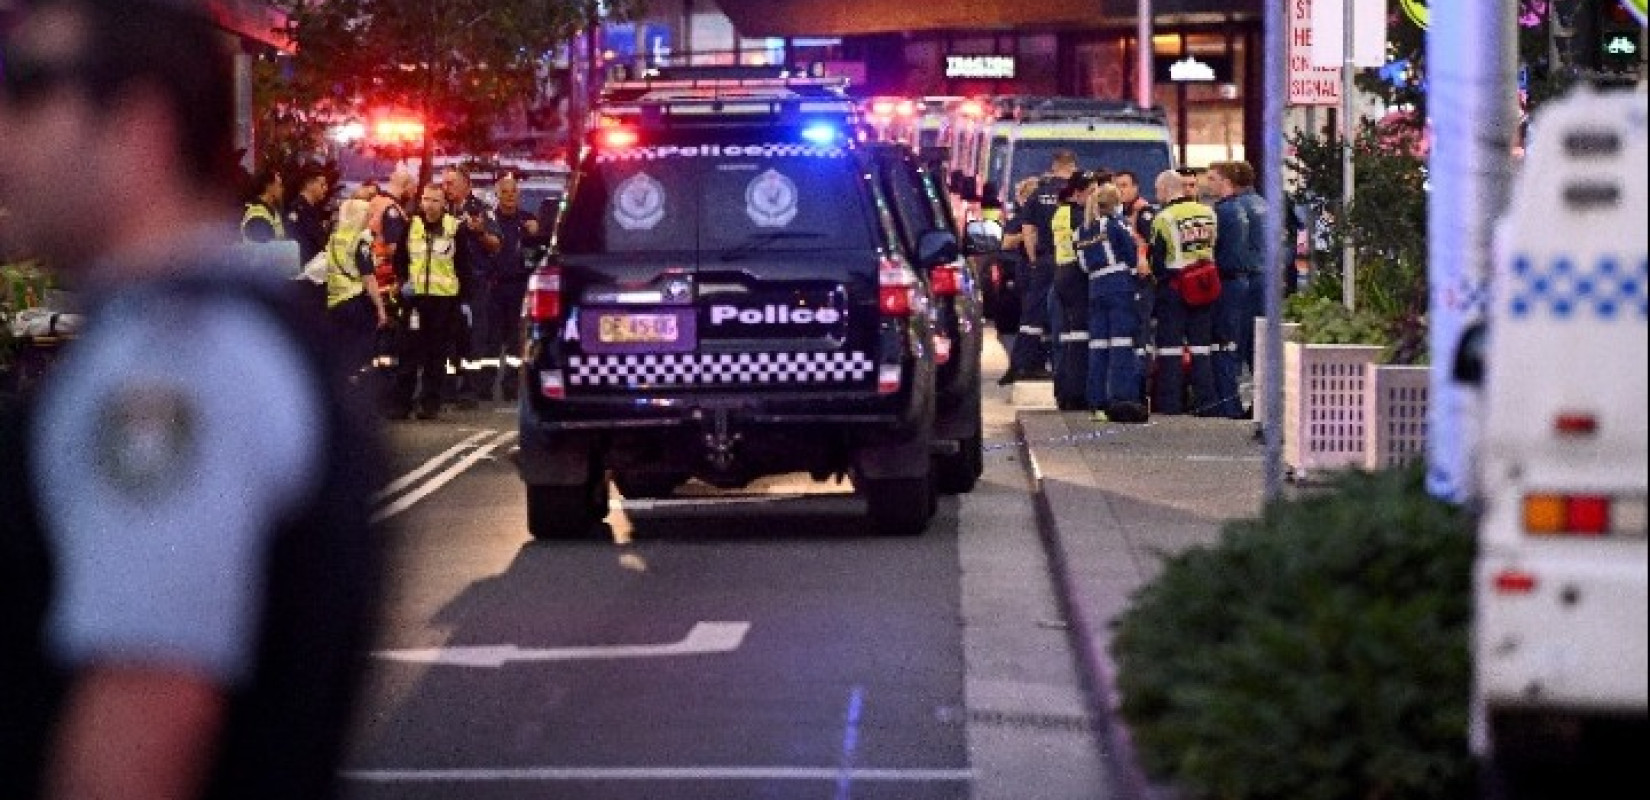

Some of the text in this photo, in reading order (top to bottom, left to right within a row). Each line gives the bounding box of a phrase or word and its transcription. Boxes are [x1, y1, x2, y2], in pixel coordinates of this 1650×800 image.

[1296, 0, 1312, 19] ST
[1294, 28, 1313, 46] HE
[1292, 80, 1338, 97] SIGNAL
[656, 144, 763, 158] Police
[710, 304, 840, 325] Police
